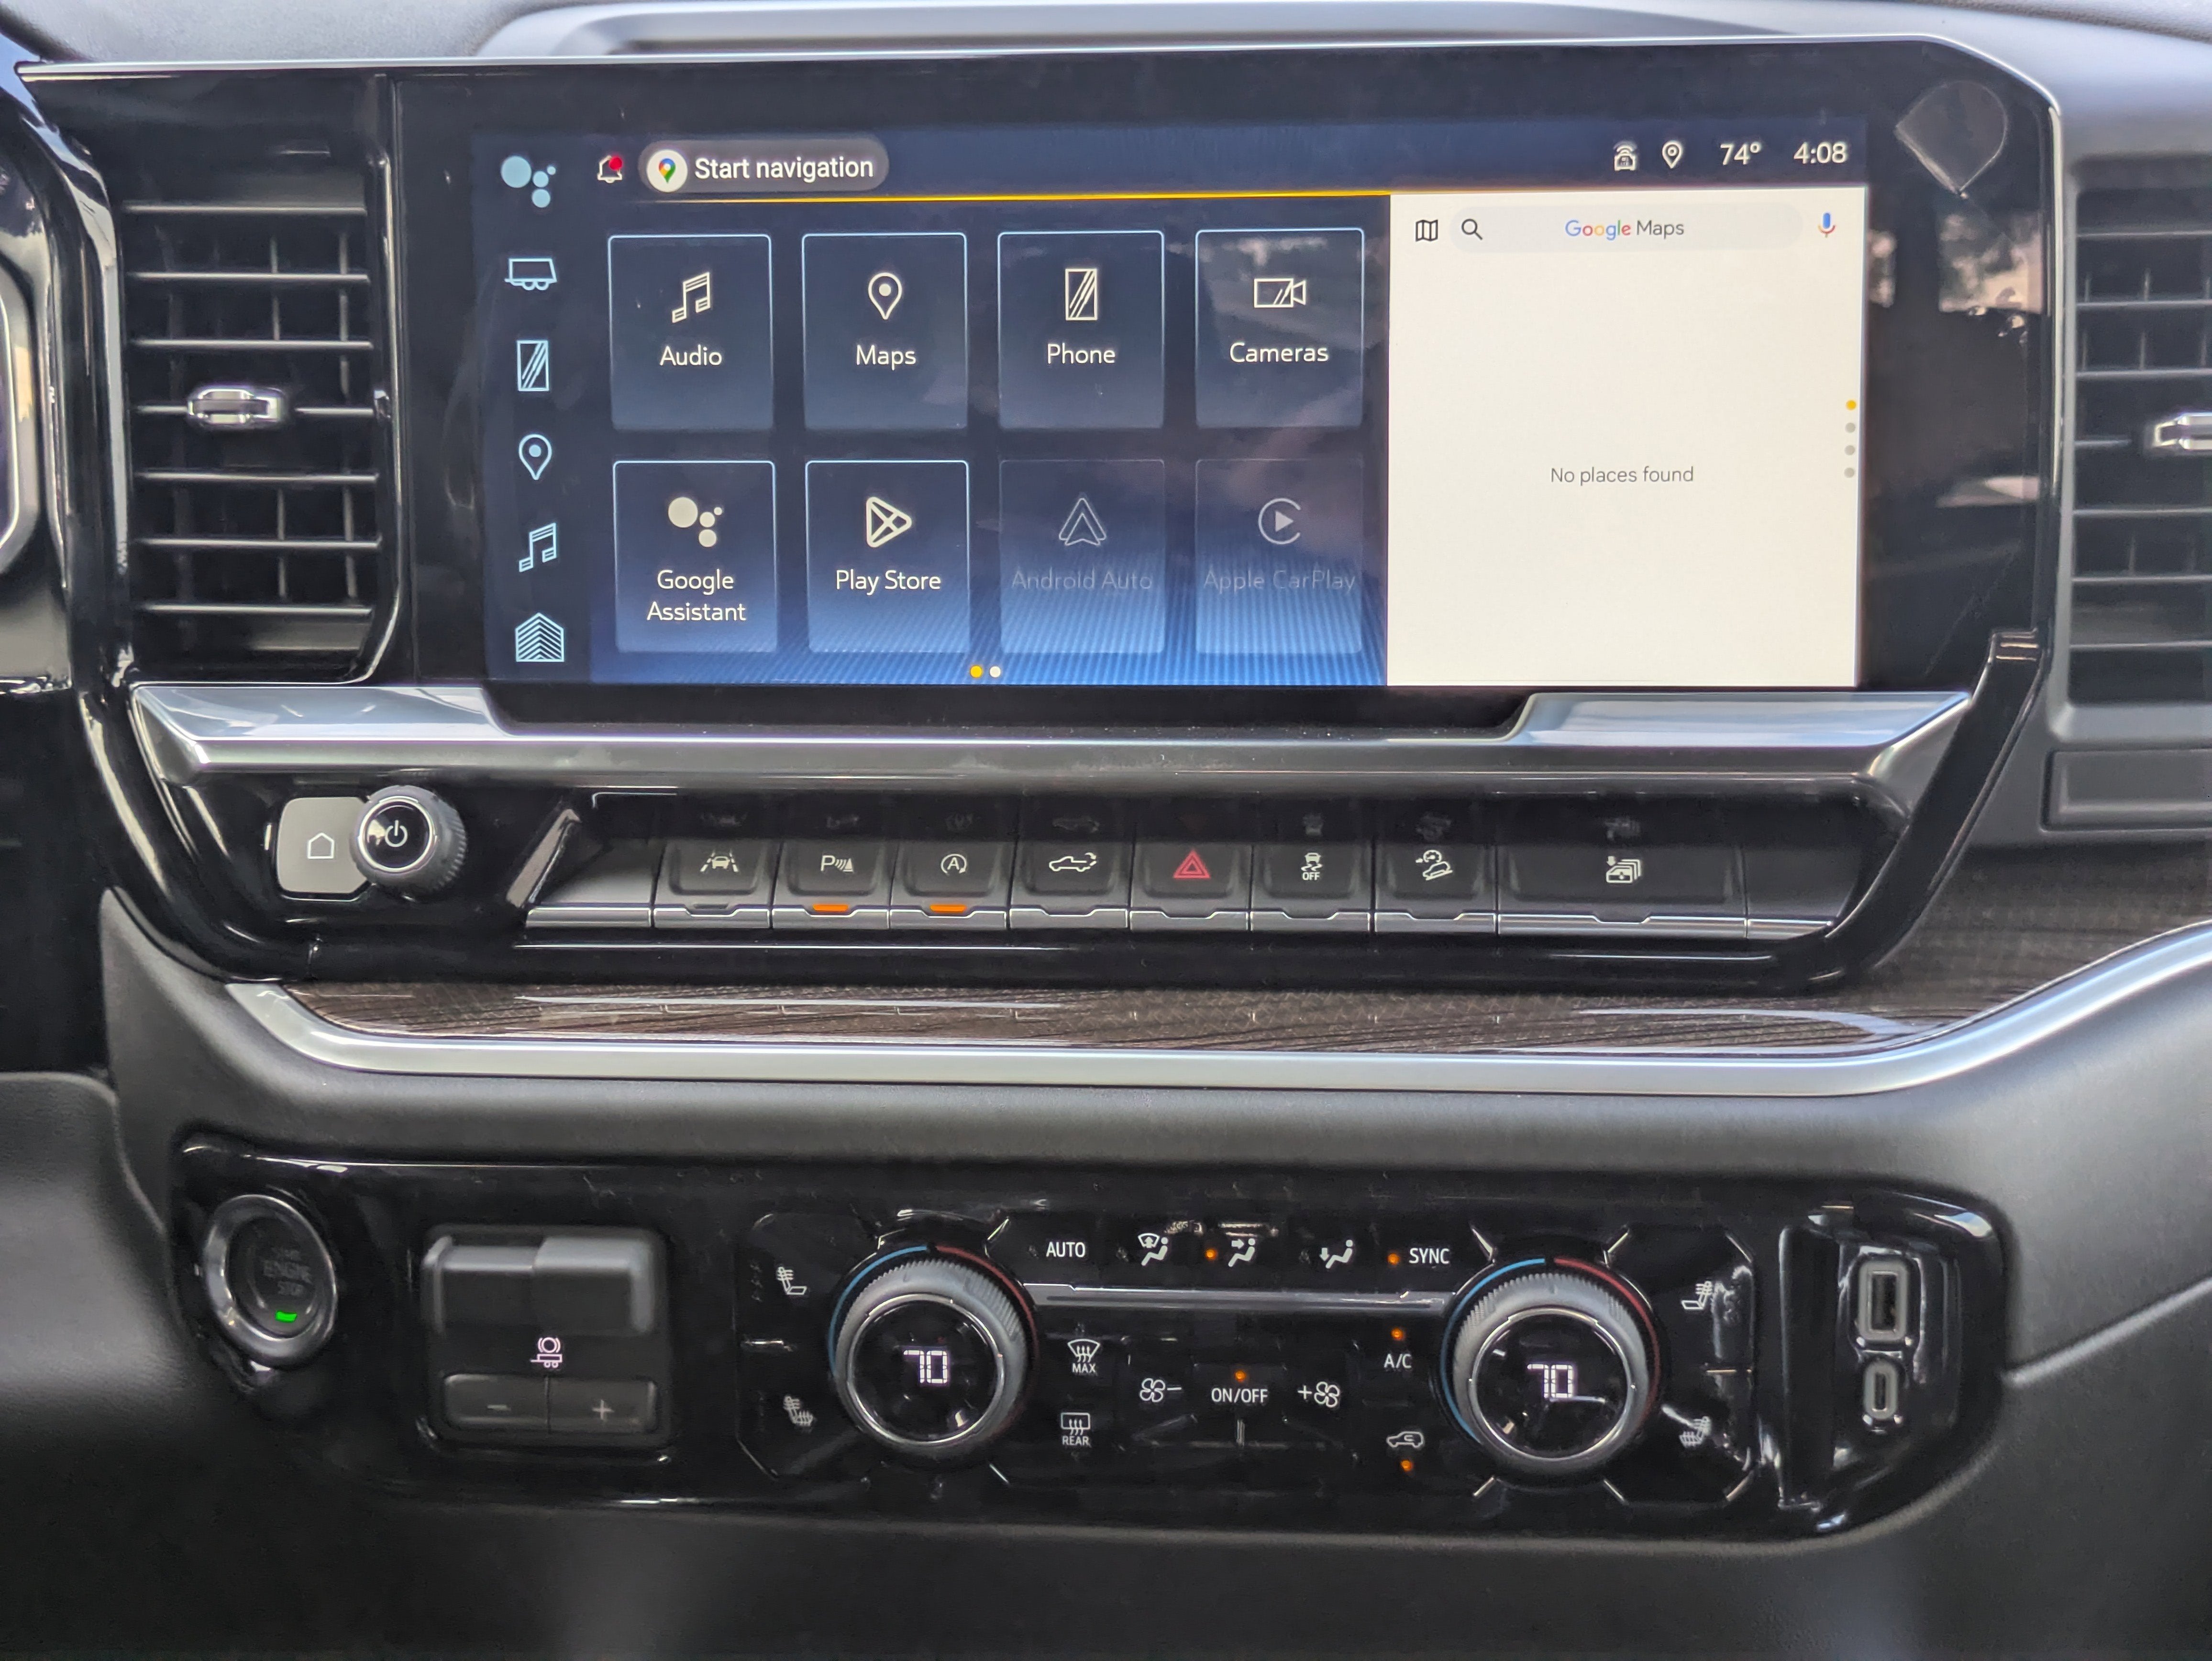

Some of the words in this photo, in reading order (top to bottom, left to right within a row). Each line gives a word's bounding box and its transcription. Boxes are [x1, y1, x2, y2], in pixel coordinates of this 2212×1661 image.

[1721, 142, 1761, 164] 74°
[1794, 142, 1847, 164] 4:08
[696, 158, 750, 178] Start
[757, 156, 873, 182] navigation
[1565, 220, 1631, 240] Google
[1637, 220, 1684, 239] Maps
[660, 344, 722, 365] Audio
[857, 344, 916, 370] Maps
[1048, 343, 1115, 364] Phone
[1230, 342, 1328, 362] Cameras
[1552, 468, 1574, 482] No
[1581, 466, 1637, 486] places
[1643, 466, 1693, 482] found
[658, 569, 733, 595] Google
[837, 569, 879, 595] Play
[885, 570, 941, 589] Store
[1012, 568, 1095, 589] Android
[1102, 570, 1152, 589] Auto
[1203, 570, 1265, 594] Apple
[1273, 568, 1356, 595] CarPlay
[647, 601, 746, 620] Assistant
[1302, 870, 1320, 880] OFF
[1046, 1242, 1085, 1257] AUTO
[1409, 1248, 1449, 1263] SYNC
[904, 1350, 948, 1384] 70
[1073, 1363, 1095, 1373] MAX
[1384, 1354, 1411, 1368] A/C
[1527, 1364, 1574, 1398] 70
[1212, 1388, 1267, 1403] ON/OFF
[1062, 1436, 1089, 1445] REAR
